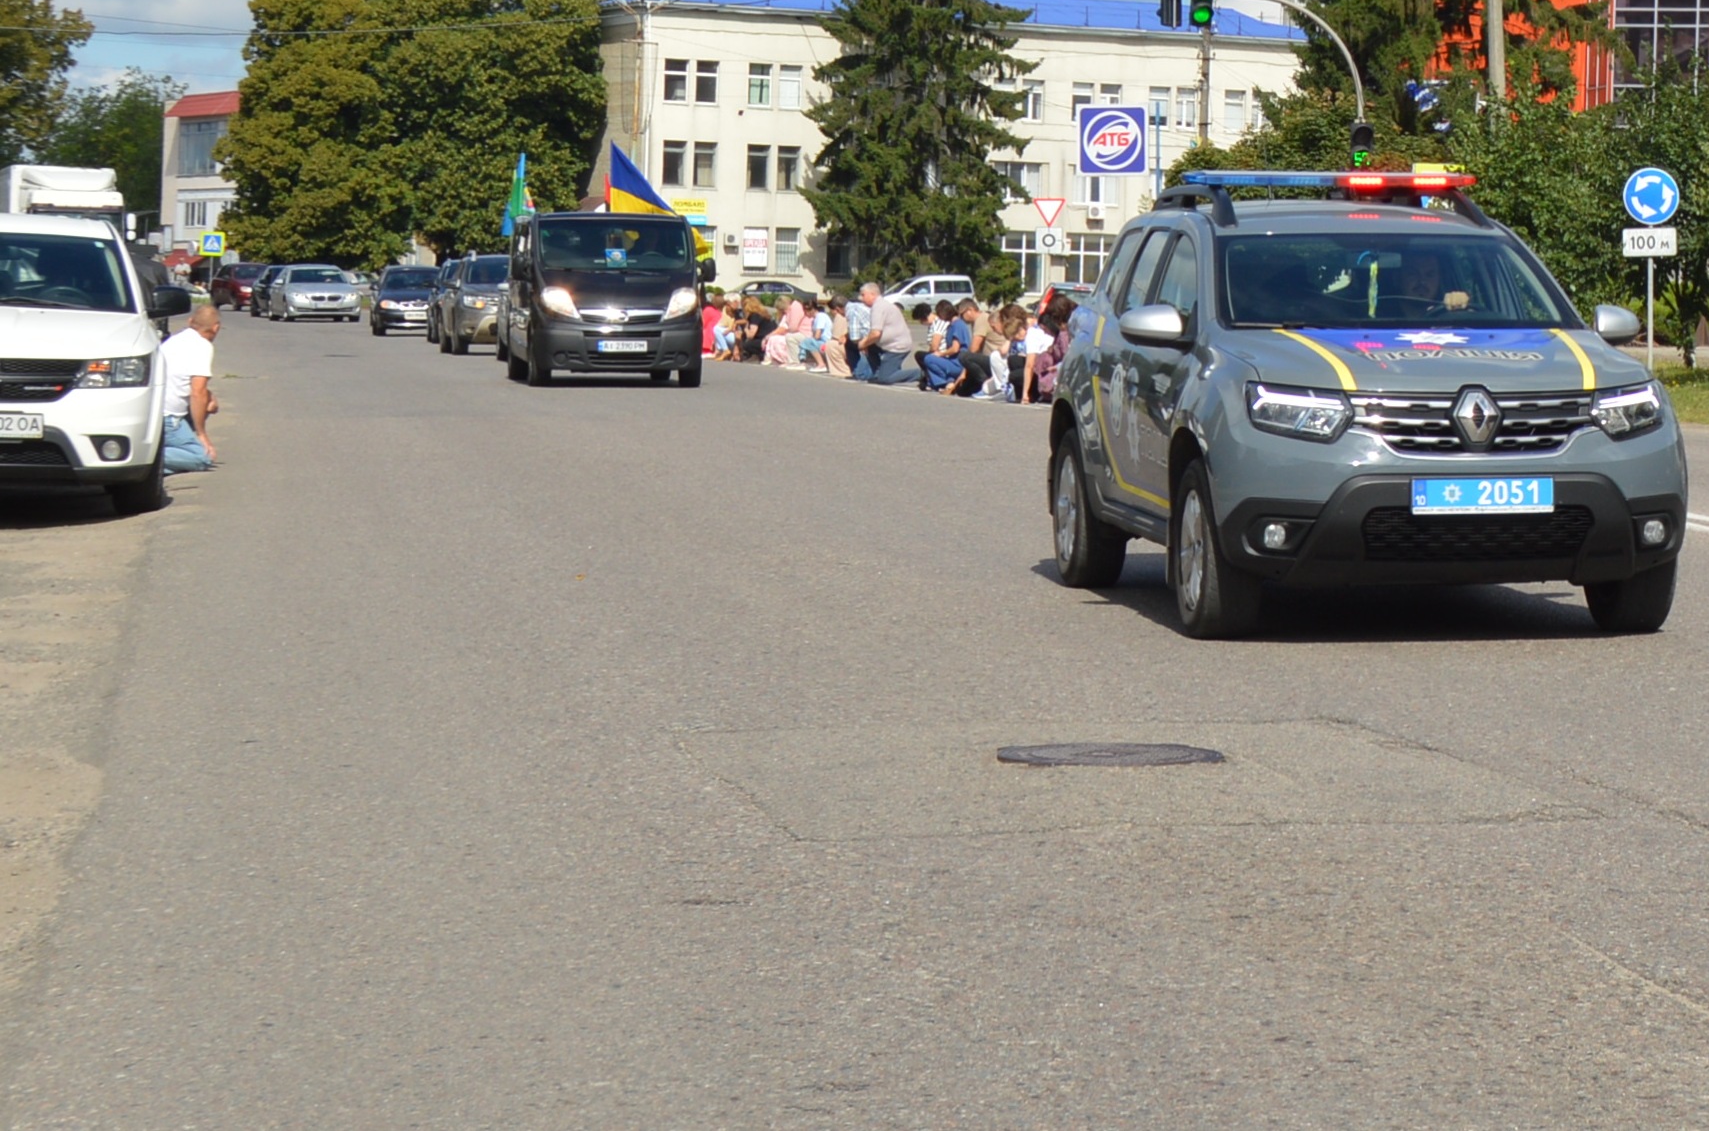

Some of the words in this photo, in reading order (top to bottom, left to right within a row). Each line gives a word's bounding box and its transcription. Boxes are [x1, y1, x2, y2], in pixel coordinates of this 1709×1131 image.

[1093, 131, 1131, 147] АТБ
[1630, 235, 1656, 250] 100
[1415, 494, 1426, 506] 10
[1477, 480, 1540, 505] 2051
